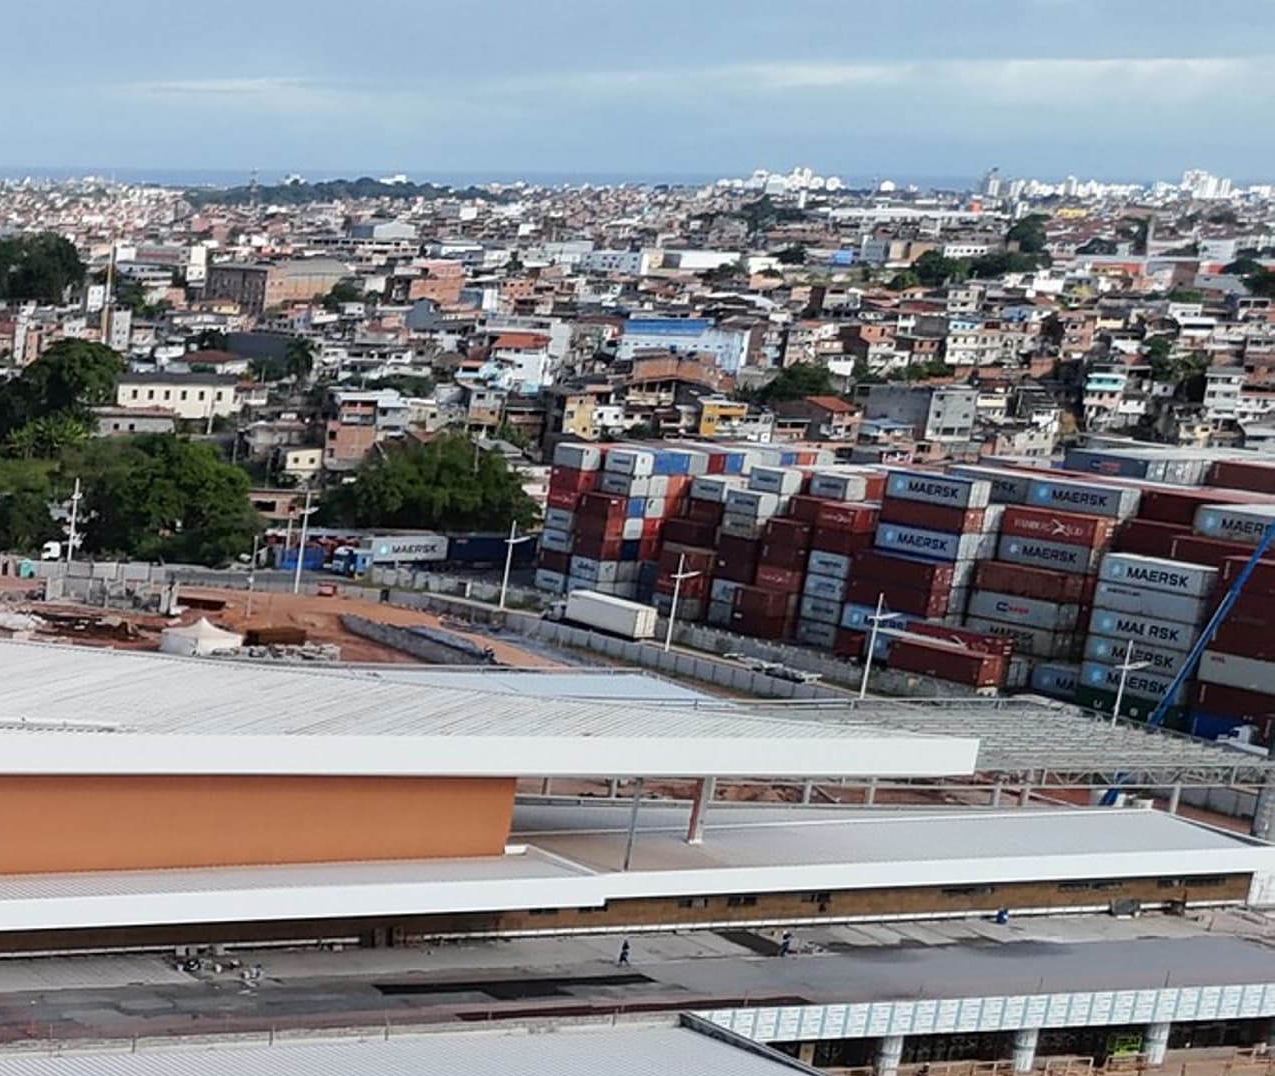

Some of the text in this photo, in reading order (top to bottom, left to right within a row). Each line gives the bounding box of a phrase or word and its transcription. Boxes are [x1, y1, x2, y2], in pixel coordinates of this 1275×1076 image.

[908, 481, 959, 499] MAERSK
[1052, 488, 1108, 507] MAERSK
[392, 544, 438, 554] MAERSK
[897, 533, 948, 551] MAERSK
[1022, 545, 1078, 564] MAERSK
[1126, 566, 1190, 588] MAERSK
